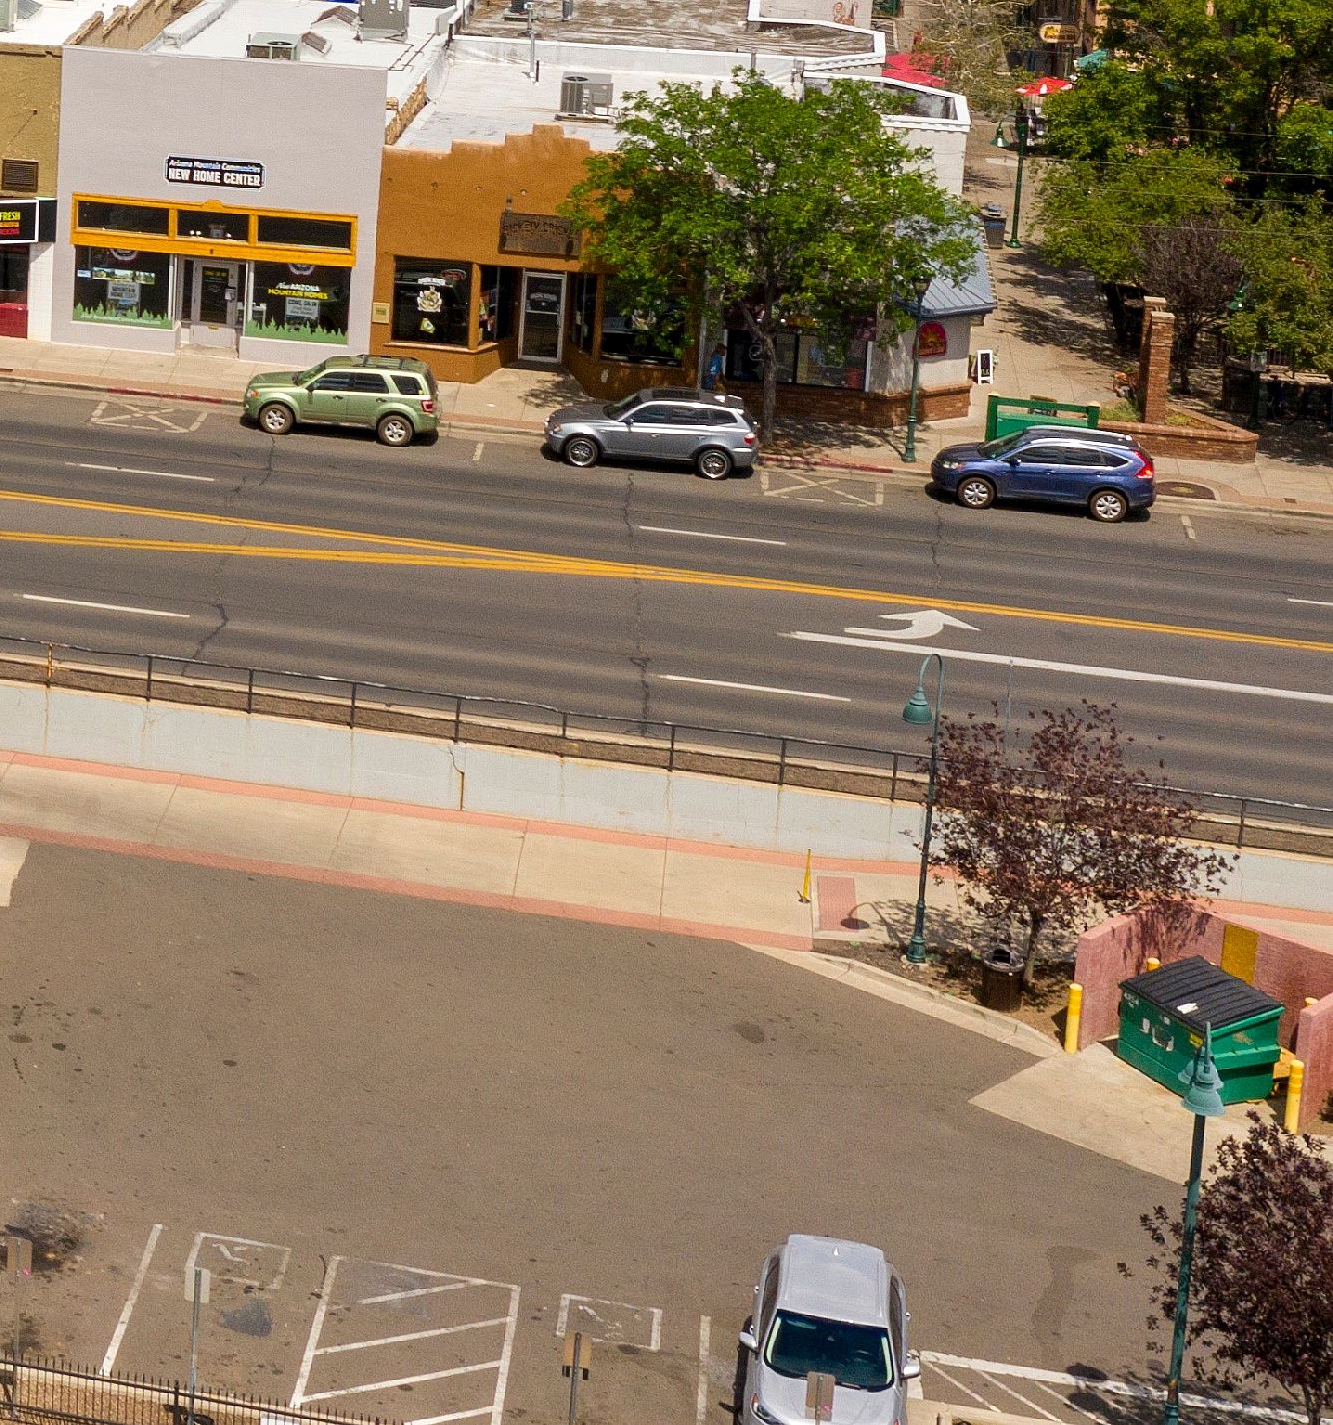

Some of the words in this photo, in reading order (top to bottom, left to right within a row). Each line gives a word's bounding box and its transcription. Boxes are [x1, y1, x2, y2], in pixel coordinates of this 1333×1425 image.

[169, 167, 191, 180] NEW
[193, 169, 221, 184] HOME
[223, 172, 261, 186] CENTER
[0, 211, 20, 221] FRESH
[268, 288, 303, 297] MOUNTAIN
[305, 291, 328, 300] HOMES
